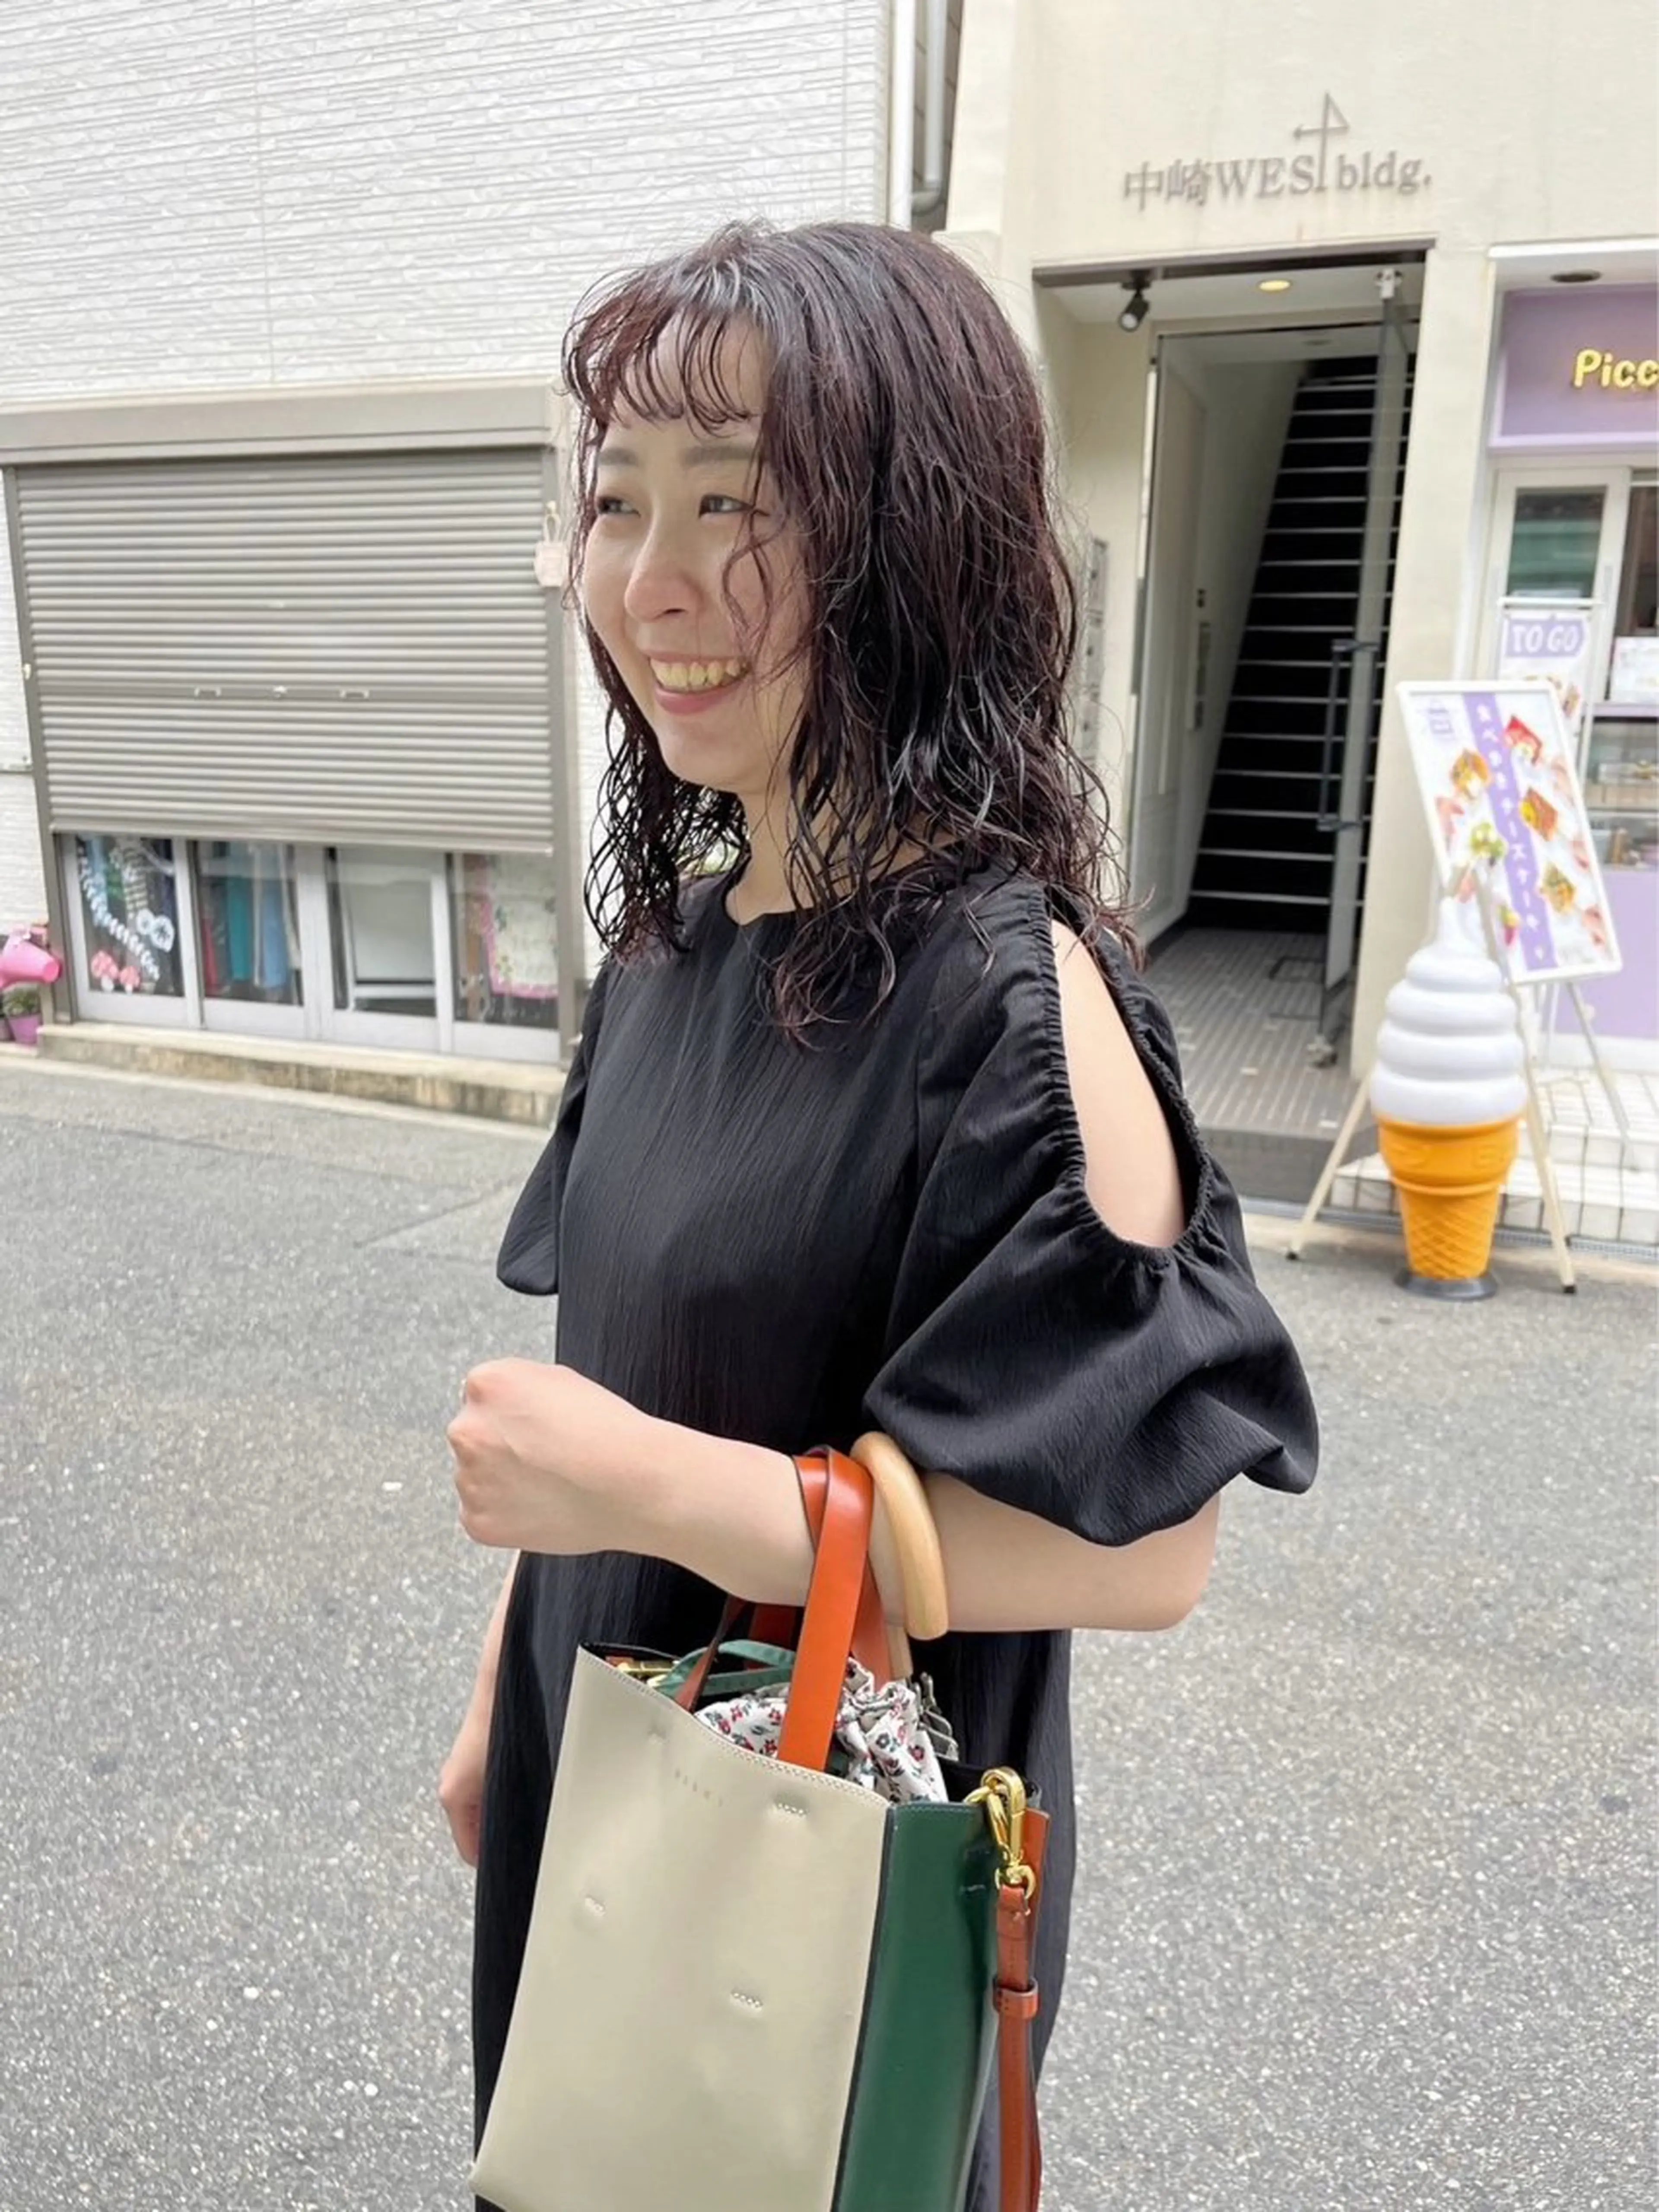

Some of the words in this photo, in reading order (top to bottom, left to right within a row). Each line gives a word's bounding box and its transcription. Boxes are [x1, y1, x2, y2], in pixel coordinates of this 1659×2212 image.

[1336, 150, 1432, 195] bldg.
[1513, 624, 1544, 653] TO
[1547, 624, 1579, 653] GO
